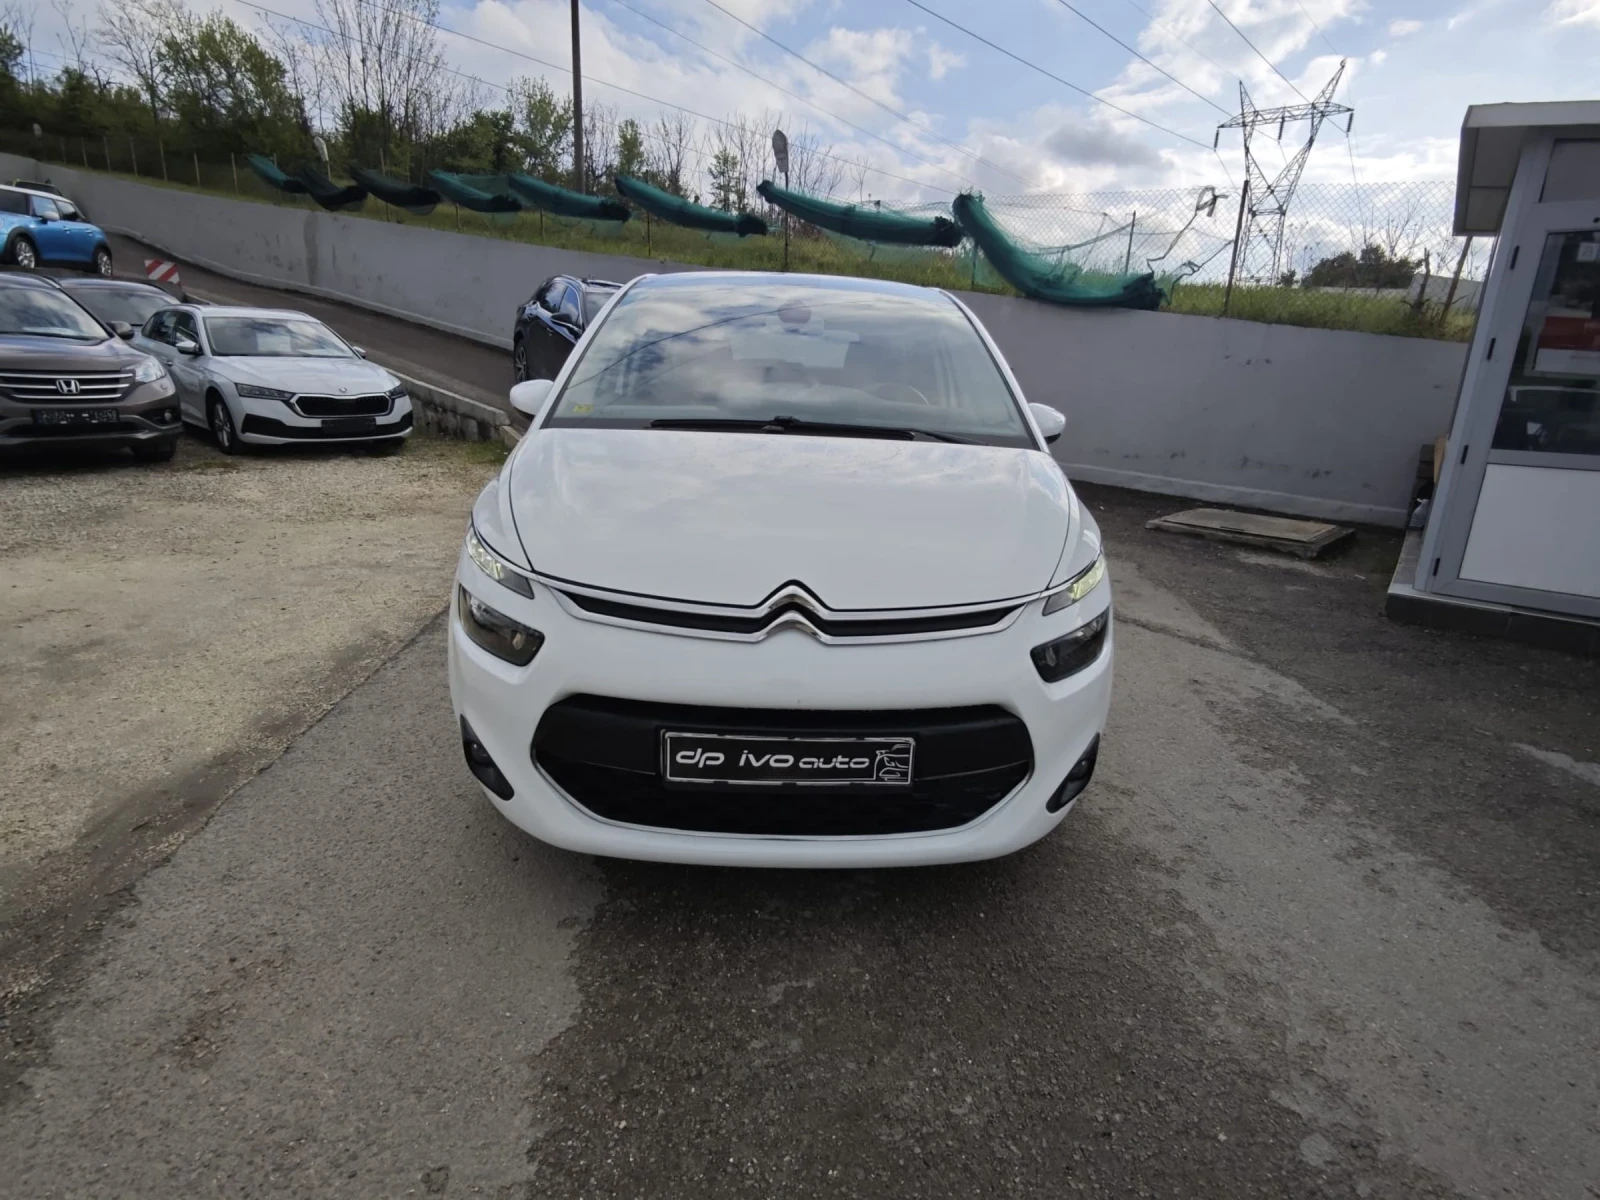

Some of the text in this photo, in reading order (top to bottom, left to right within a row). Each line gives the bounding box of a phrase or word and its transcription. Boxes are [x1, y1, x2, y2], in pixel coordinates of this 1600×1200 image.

[675, 747, 870, 769] dp ivo auto
